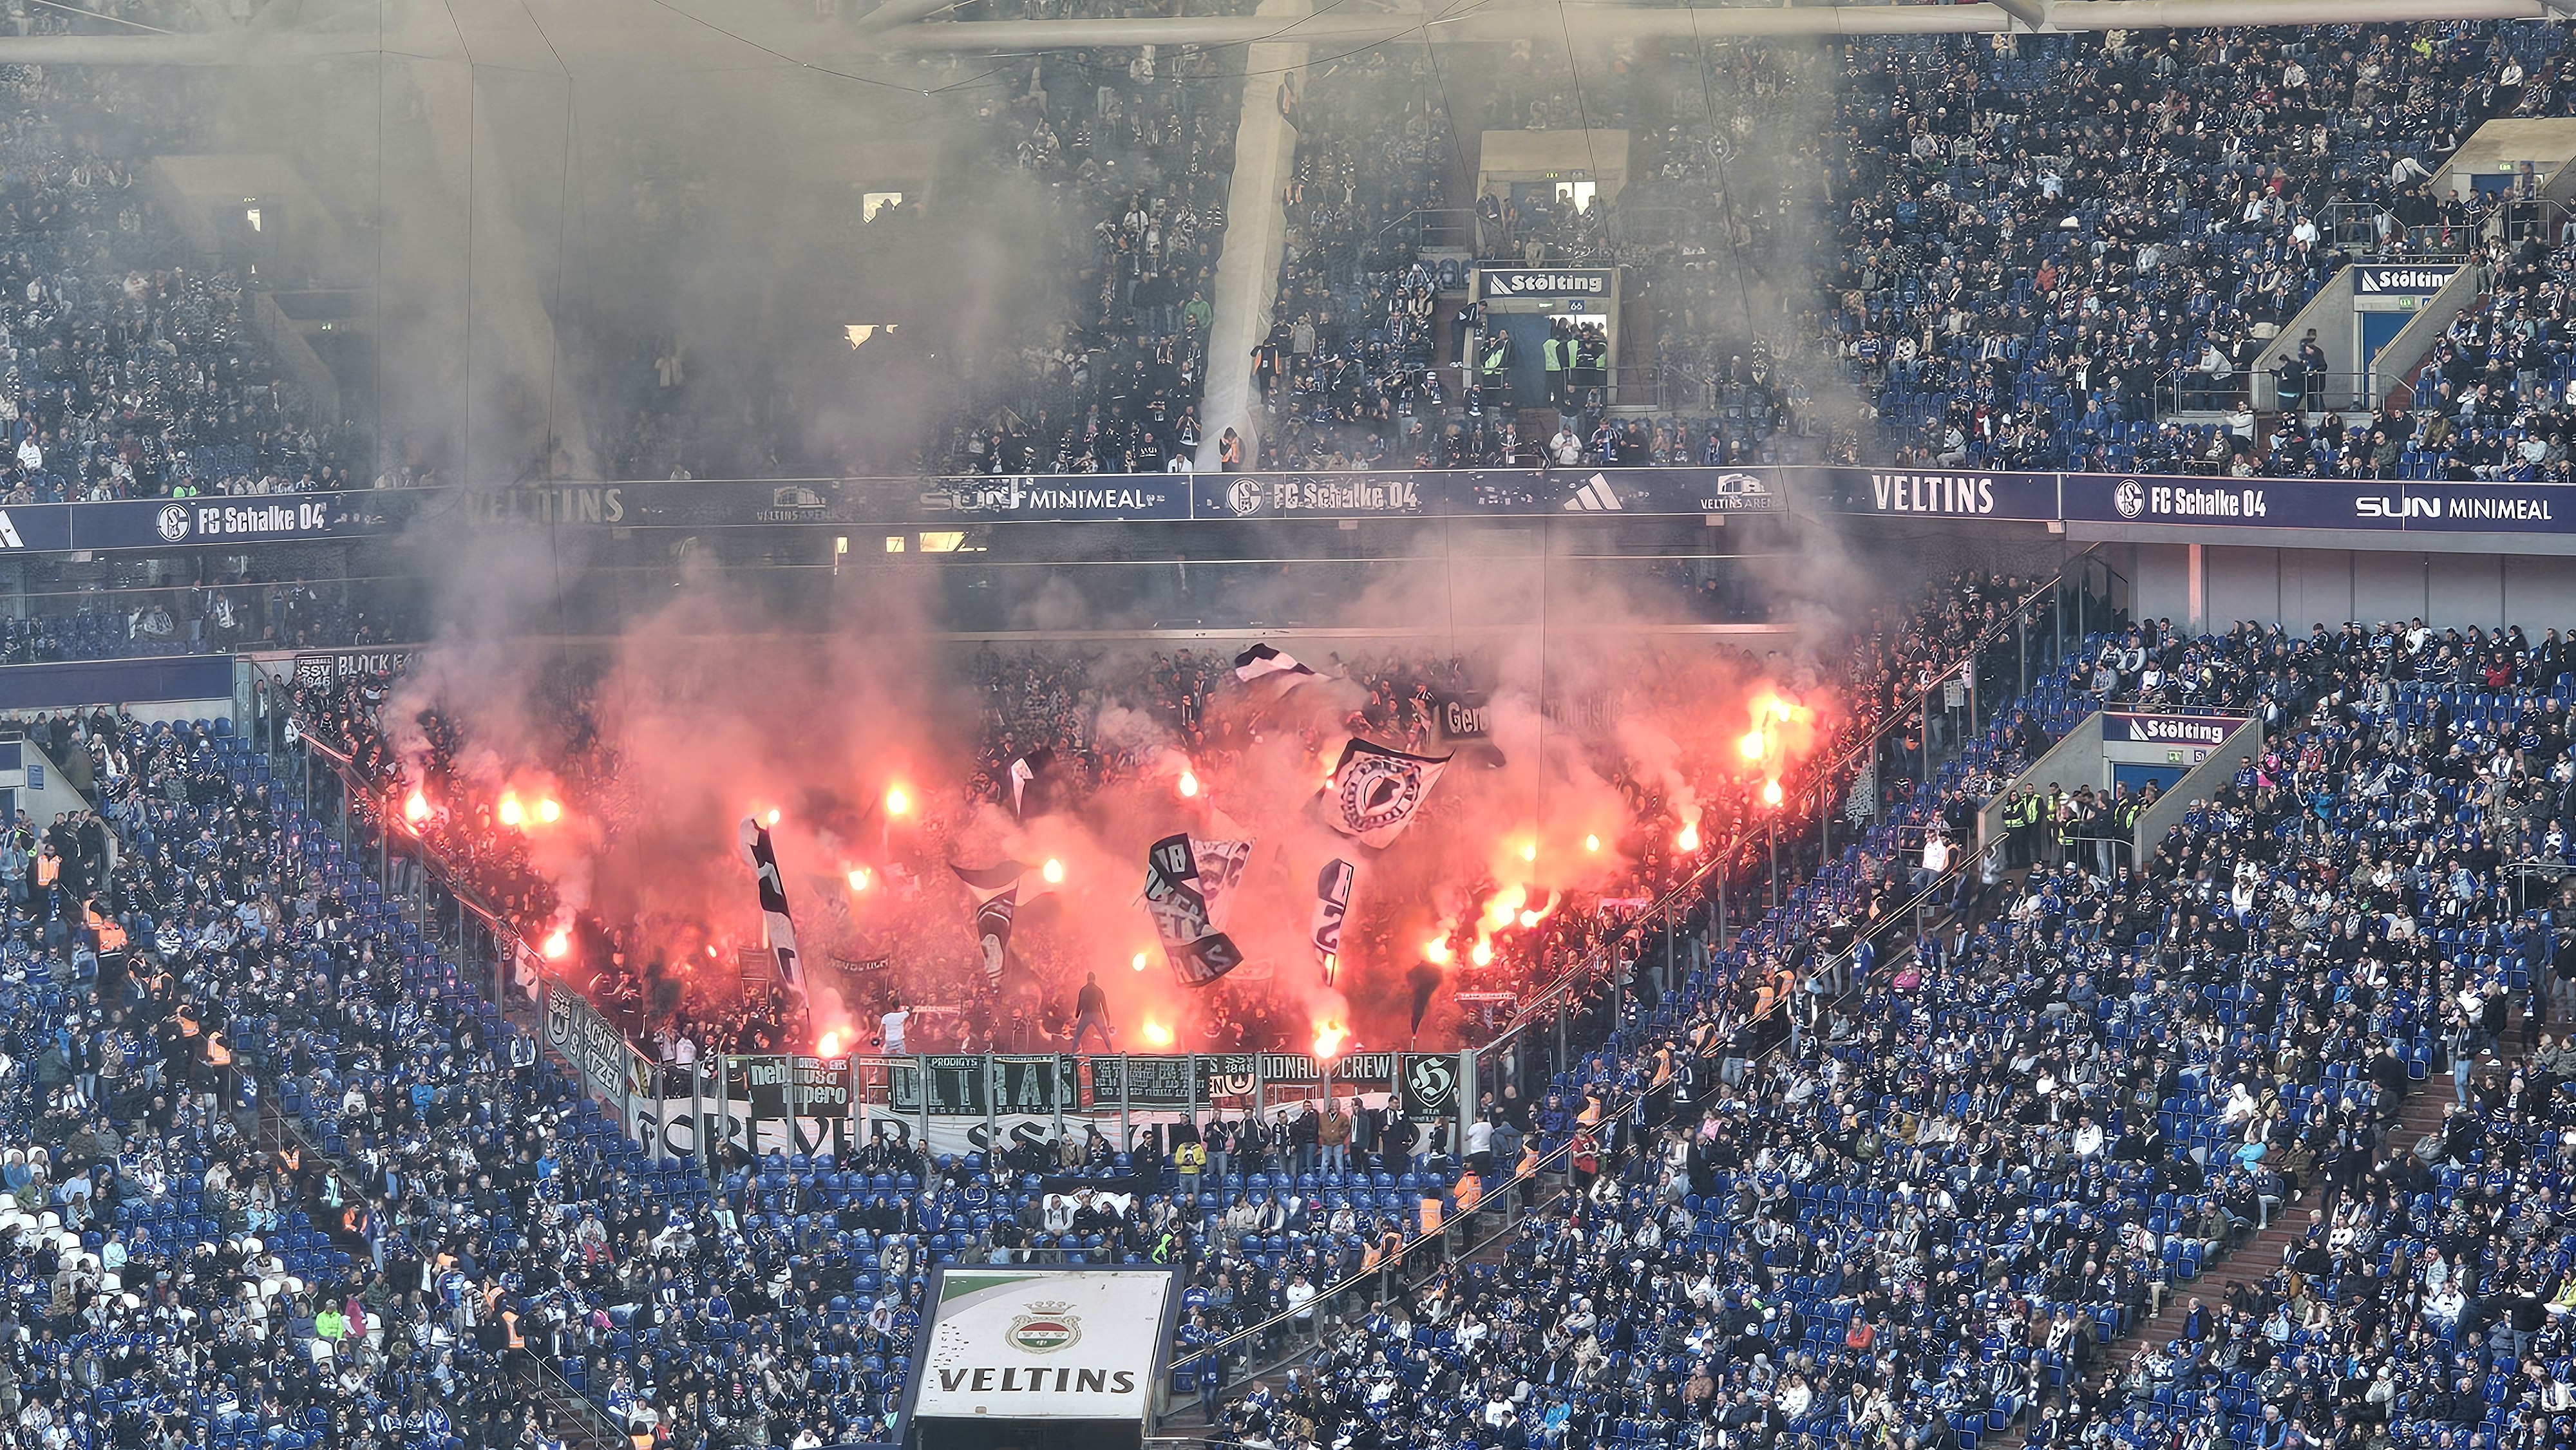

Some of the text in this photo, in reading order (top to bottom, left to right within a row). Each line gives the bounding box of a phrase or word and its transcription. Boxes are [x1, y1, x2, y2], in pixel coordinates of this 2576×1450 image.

[1511, 274, 1602, 292] Stölting
[2379, 270, 2455, 288] Stöltin
[1570, 302, 1583, 310] 66
[1030, 489, 1146, 509] MINIMEAL
[1274, 482, 1416, 509] FC Schalke 04
[1701, 499, 1742, 509] VELTINS
[1871, 475, 1994, 513] VELTINS
[2152, 487, 2266, 517] FC Schalke 04
[199, 503, 325, 534] FC Schalke 04
[2356, 497, 2552, 519] SUN MINIMEAL
[339, 654, 389, 675] BLOCK
[2147, 720, 2223, 743] Stölting
[1341, 1056, 1390, 1078] CREW
[938, 1368, 1135, 1394] VELTINS
